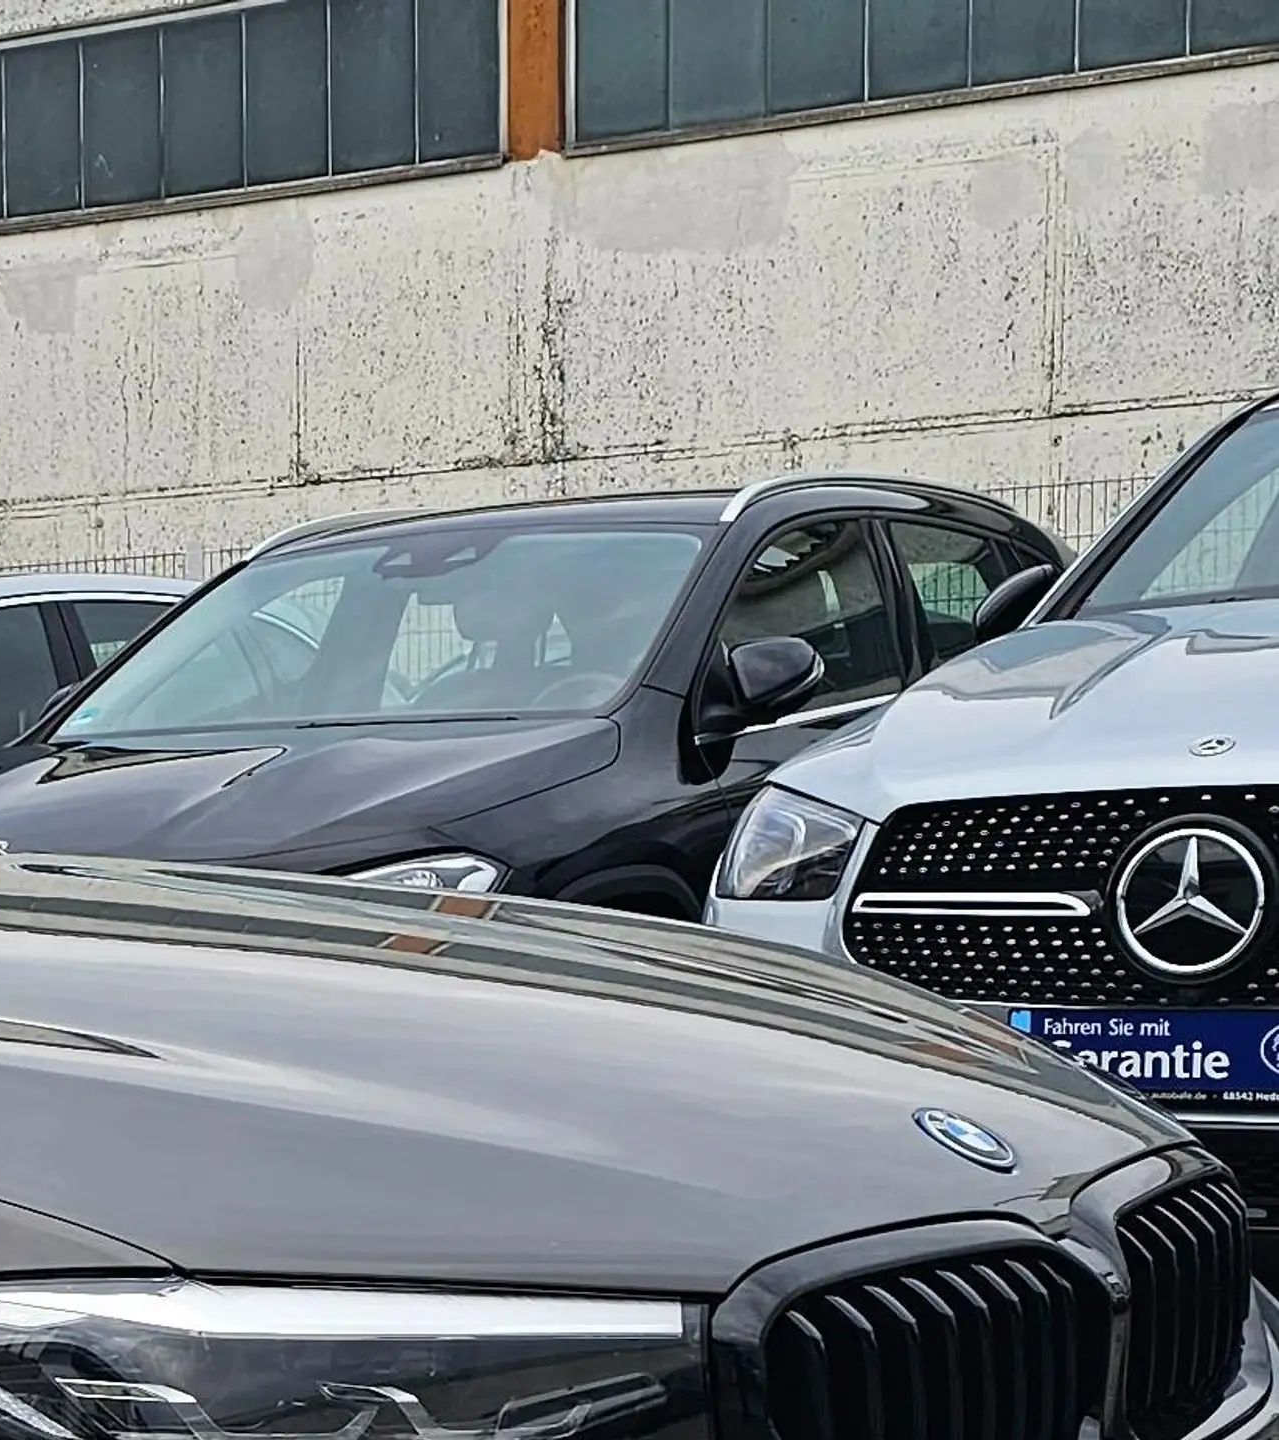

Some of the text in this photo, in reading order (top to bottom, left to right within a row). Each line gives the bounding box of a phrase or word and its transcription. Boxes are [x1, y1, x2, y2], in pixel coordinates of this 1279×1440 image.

[1043, 1018, 1171, 1036] Fahren Sie mit
[1052, 1041, 1231, 1079] arantie
